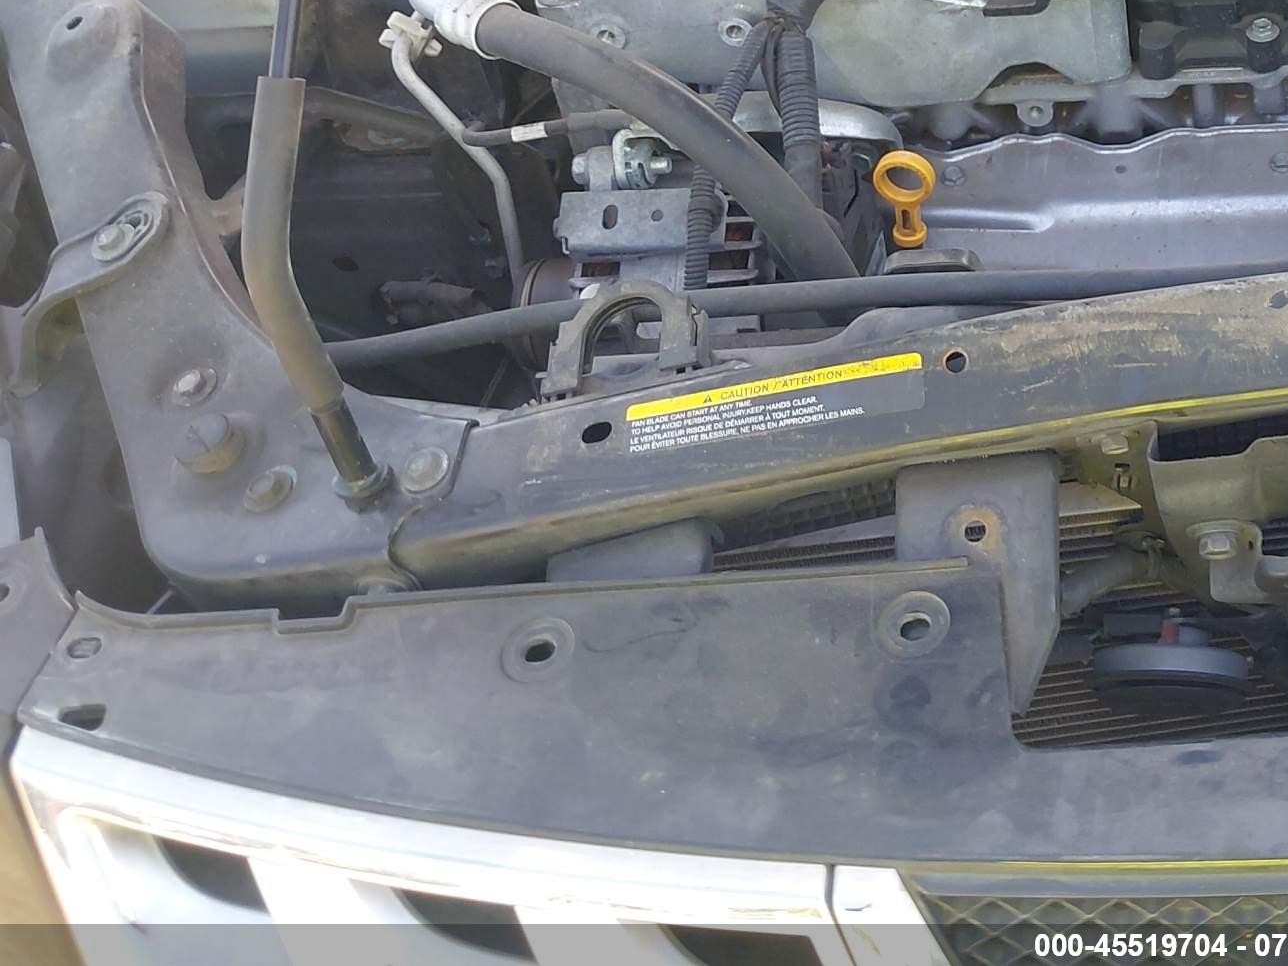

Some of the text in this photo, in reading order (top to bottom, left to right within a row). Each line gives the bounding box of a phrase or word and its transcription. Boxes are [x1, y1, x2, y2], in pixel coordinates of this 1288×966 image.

[720, 383, 769, 400] CAUTION
[782, 370, 842, 388] ATTENTION
[630, 437, 639, 445] LE
[640, 430, 685, 444] VENTILATEUR
[686, 424, 713, 436] RISQUE
[714, 422, 724, 430] DE
[725, 414, 764, 428] DÉMARRER
[772, 410, 790, 420] TOUT
[630, 443, 650, 454] POUR
[651, 438, 676, 450] ÉVITER
[676, 435, 699, 446] TOUTE
[740, 426, 751, 434] NE
[751, 422, 766, 432] PAS
[767, 420, 778, 430] EN
[778, 413, 824, 428] APPROCHER
[825, 410, 839, 420] LES
[840, 406, 865, 418] MAINS.
[632, 420, 645, 428] FAN
[646, 416, 669, 425] BLADE
[670, 412, 686, 420] CAN
[686, 408, 708, 417] START
[718, 403, 734, 412] ANY
[642, 424, 660, 434] HELP
[661, 421, 682, 430] AVOID
[684, 414, 721, 426] PERSONAL
[766, 400, 791, 412] HANDS
[792, 396, 818, 407] CLEAR.
